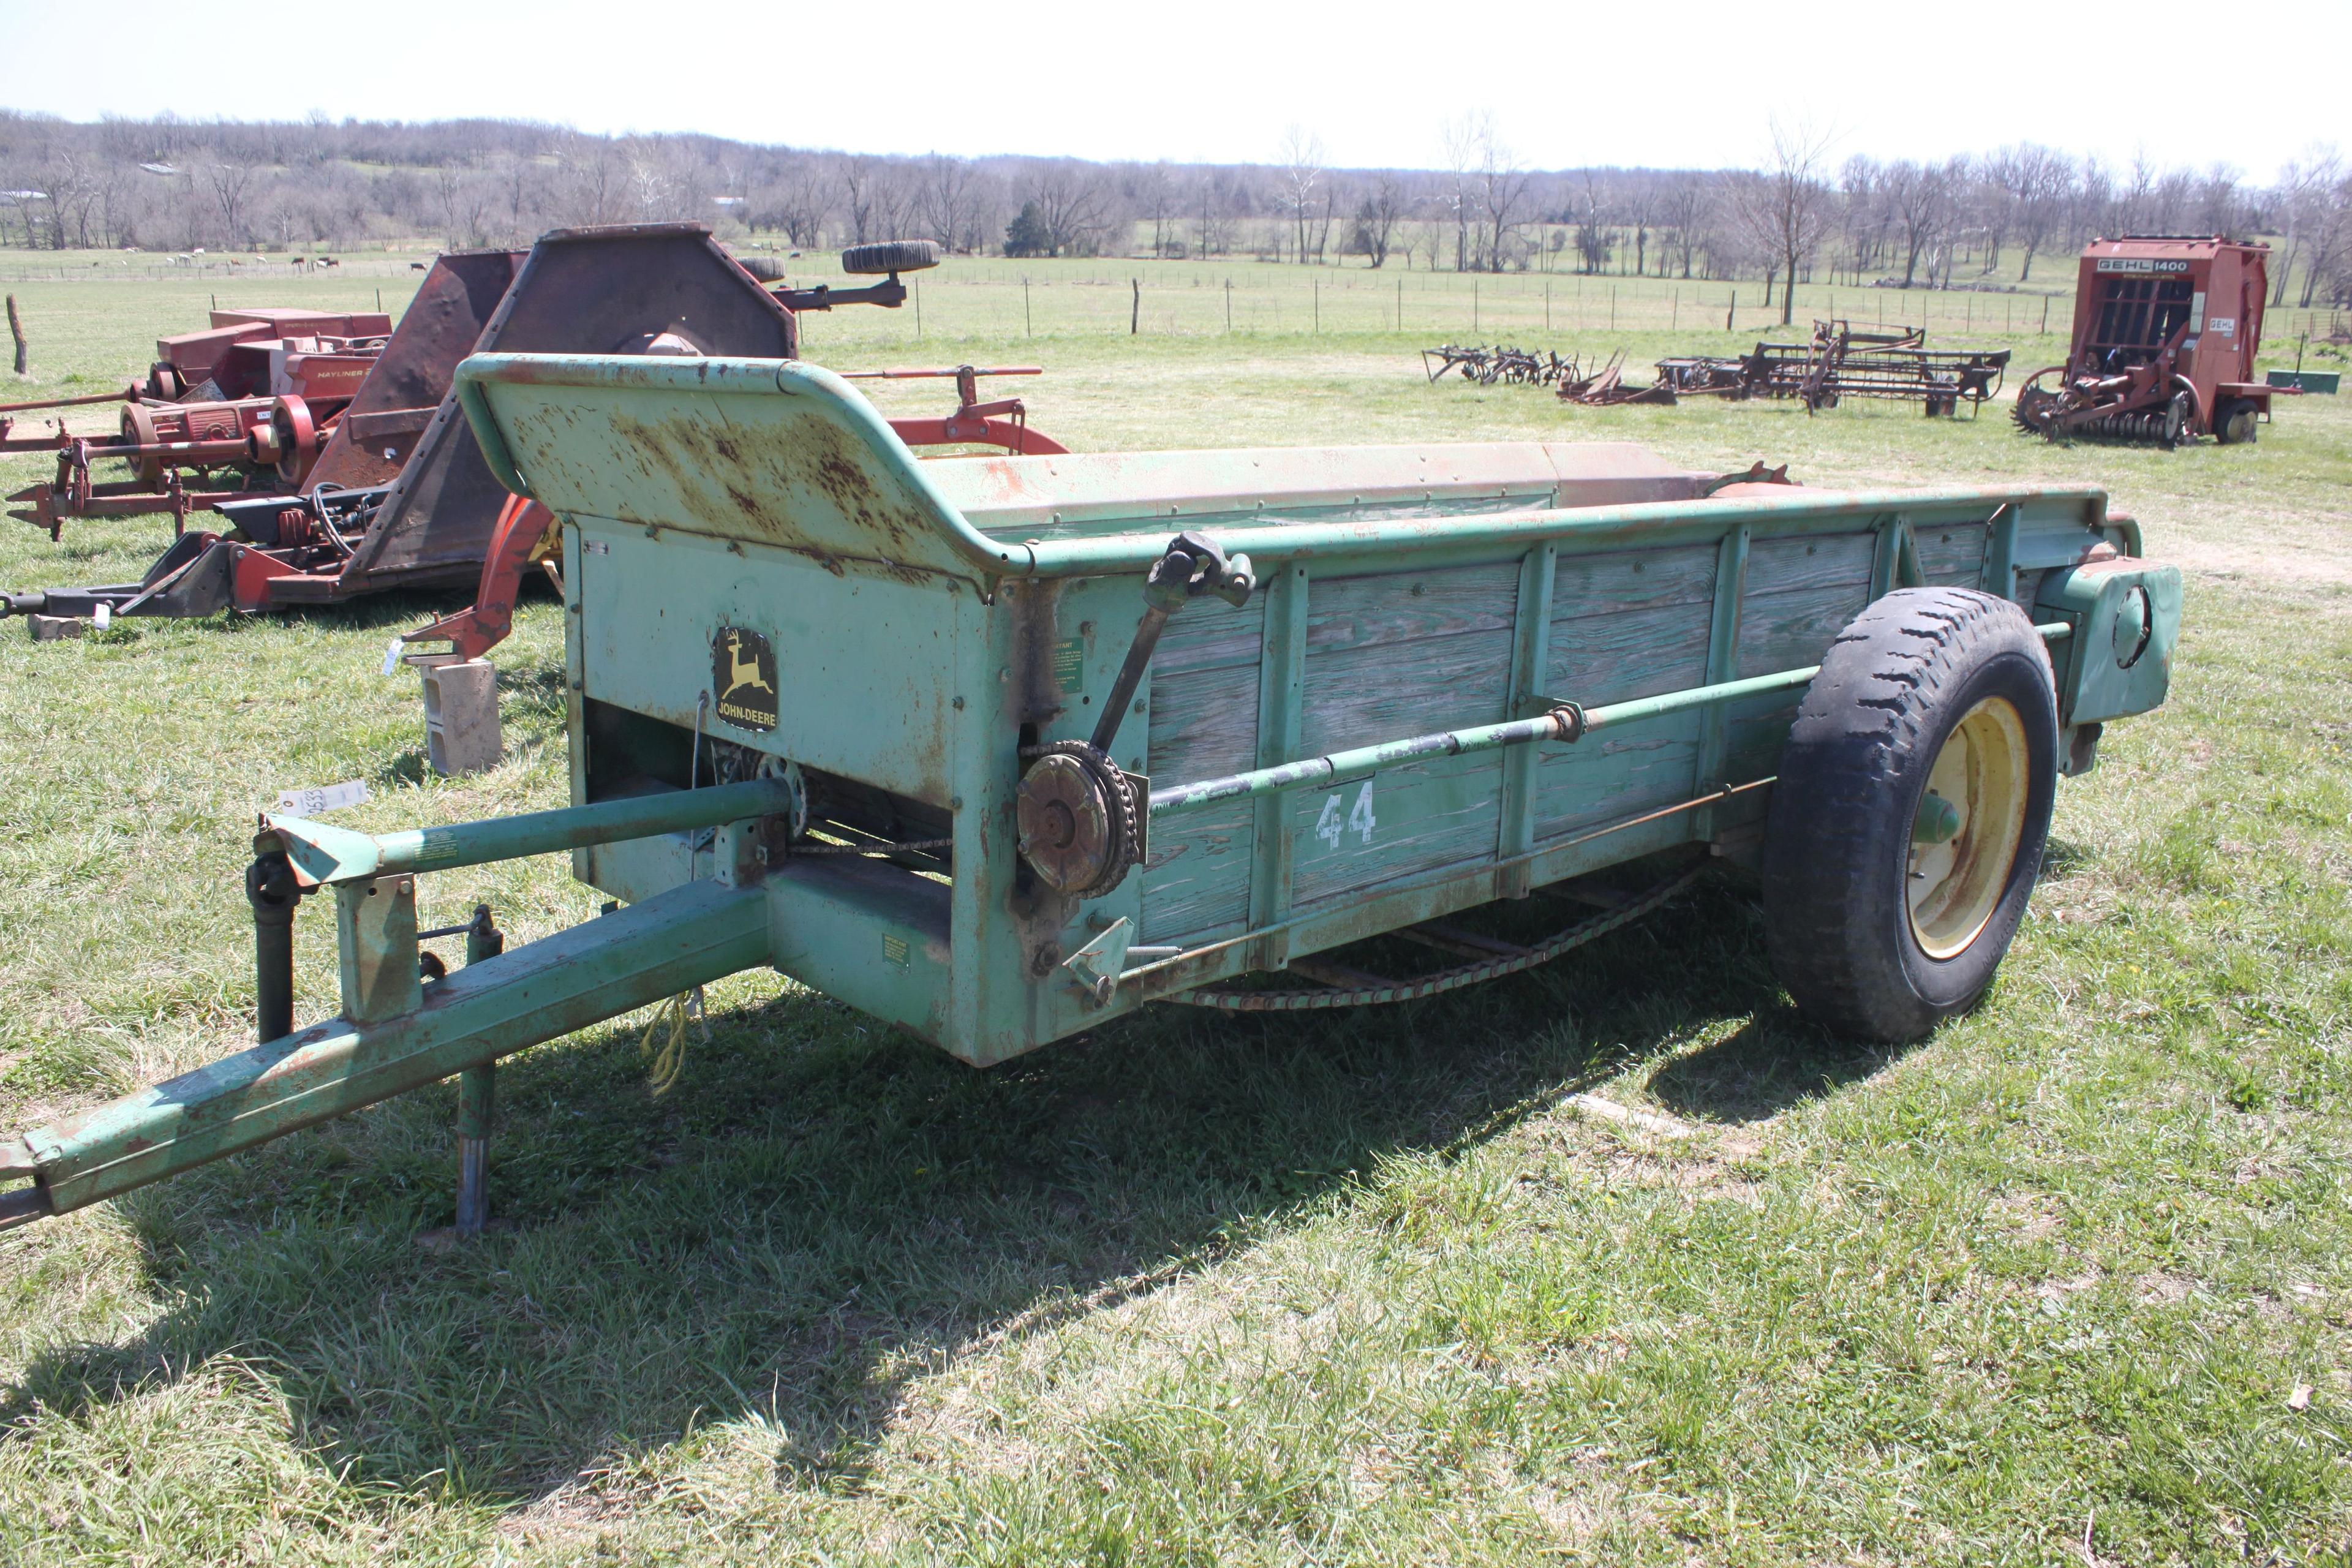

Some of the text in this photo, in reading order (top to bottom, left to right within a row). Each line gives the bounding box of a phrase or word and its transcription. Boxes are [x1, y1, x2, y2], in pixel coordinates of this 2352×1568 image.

[2098, 260, 2187, 271] GEHL 1400
[2210, 320, 2233, 329] GEHL
[1316, 781, 1376, 850] 44
